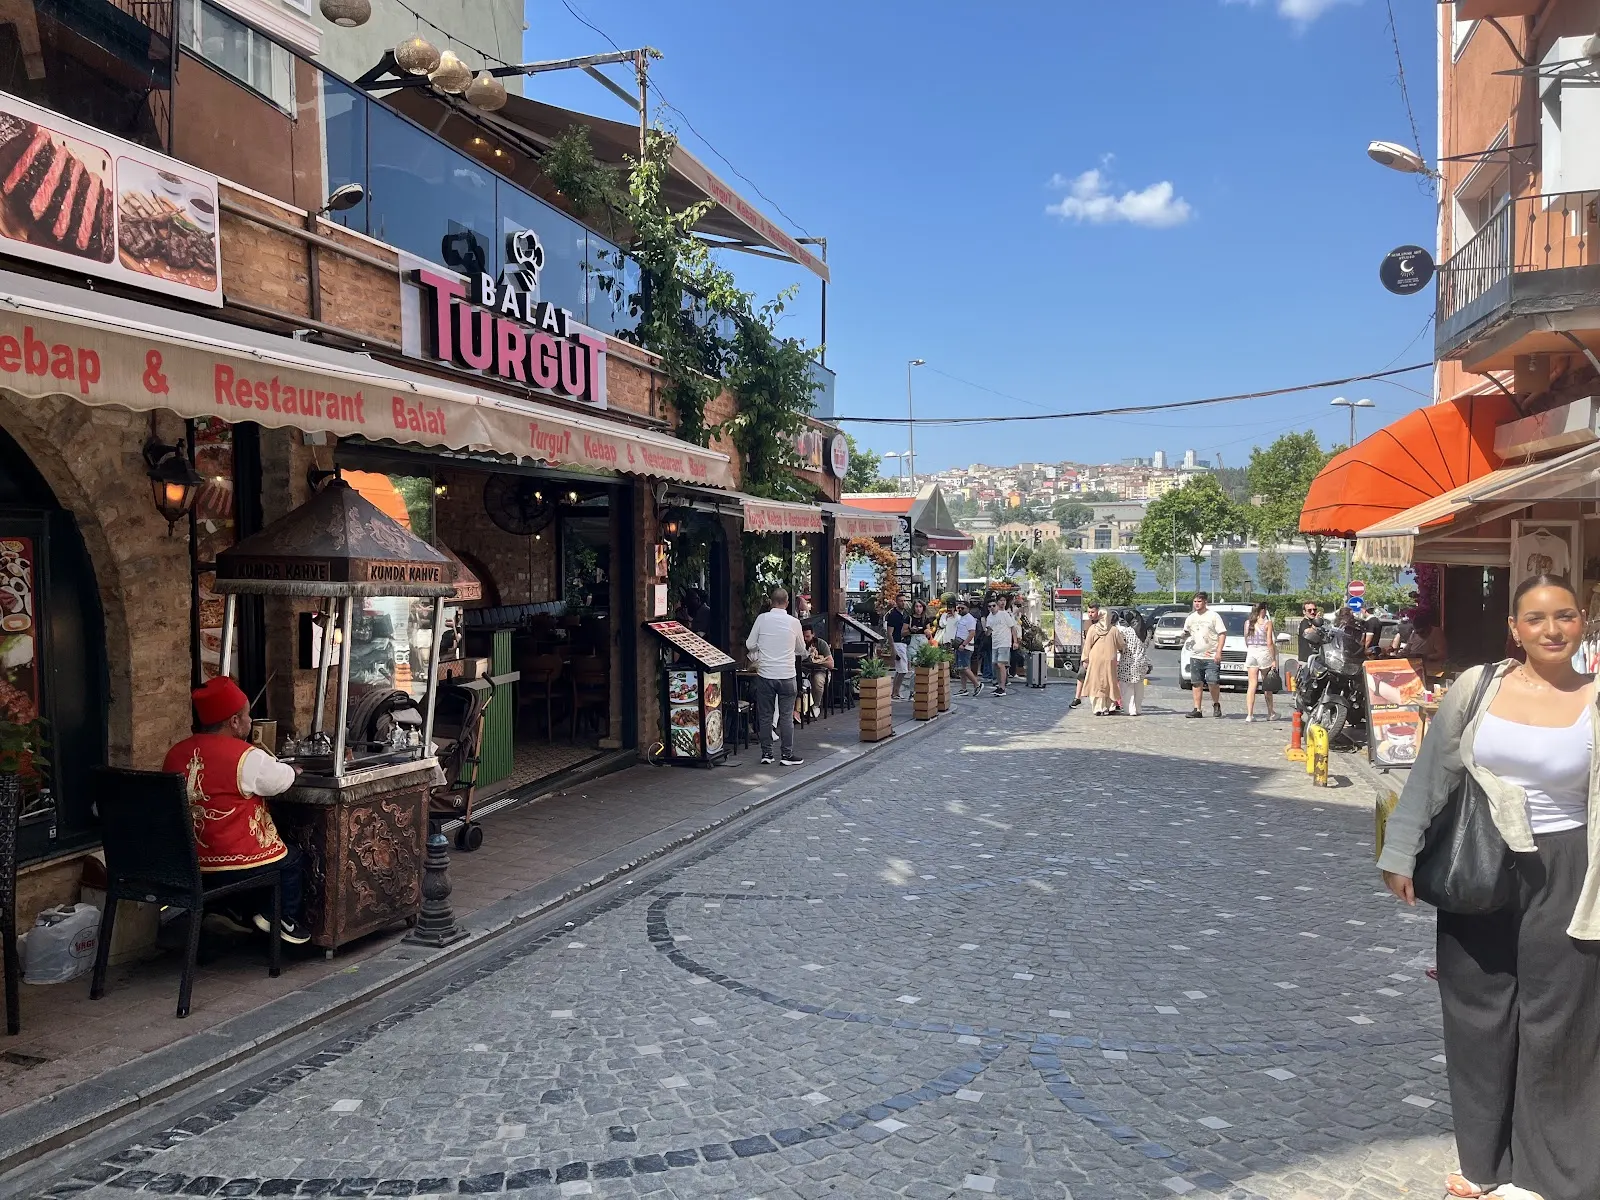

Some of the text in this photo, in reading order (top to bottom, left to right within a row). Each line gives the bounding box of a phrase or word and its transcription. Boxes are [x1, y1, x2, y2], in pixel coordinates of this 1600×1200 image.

[481, 272, 573, 337] BALAT
[419, 268, 607, 402] TURGUT
[143, 349, 170, 395] &
[214, 363, 365, 424] Restaurant
[392, 396, 447, 436] Balat
[584, 434, 617, 467] Kebap
[627, 443, 635, 464] &
[641, 446, 684, 473] Restaurant
[688, 456, 707, 478] Balat
[285, 563, 325, 580] KAHVE
[371, 565, 439, 582] KUMDA KAHVE
